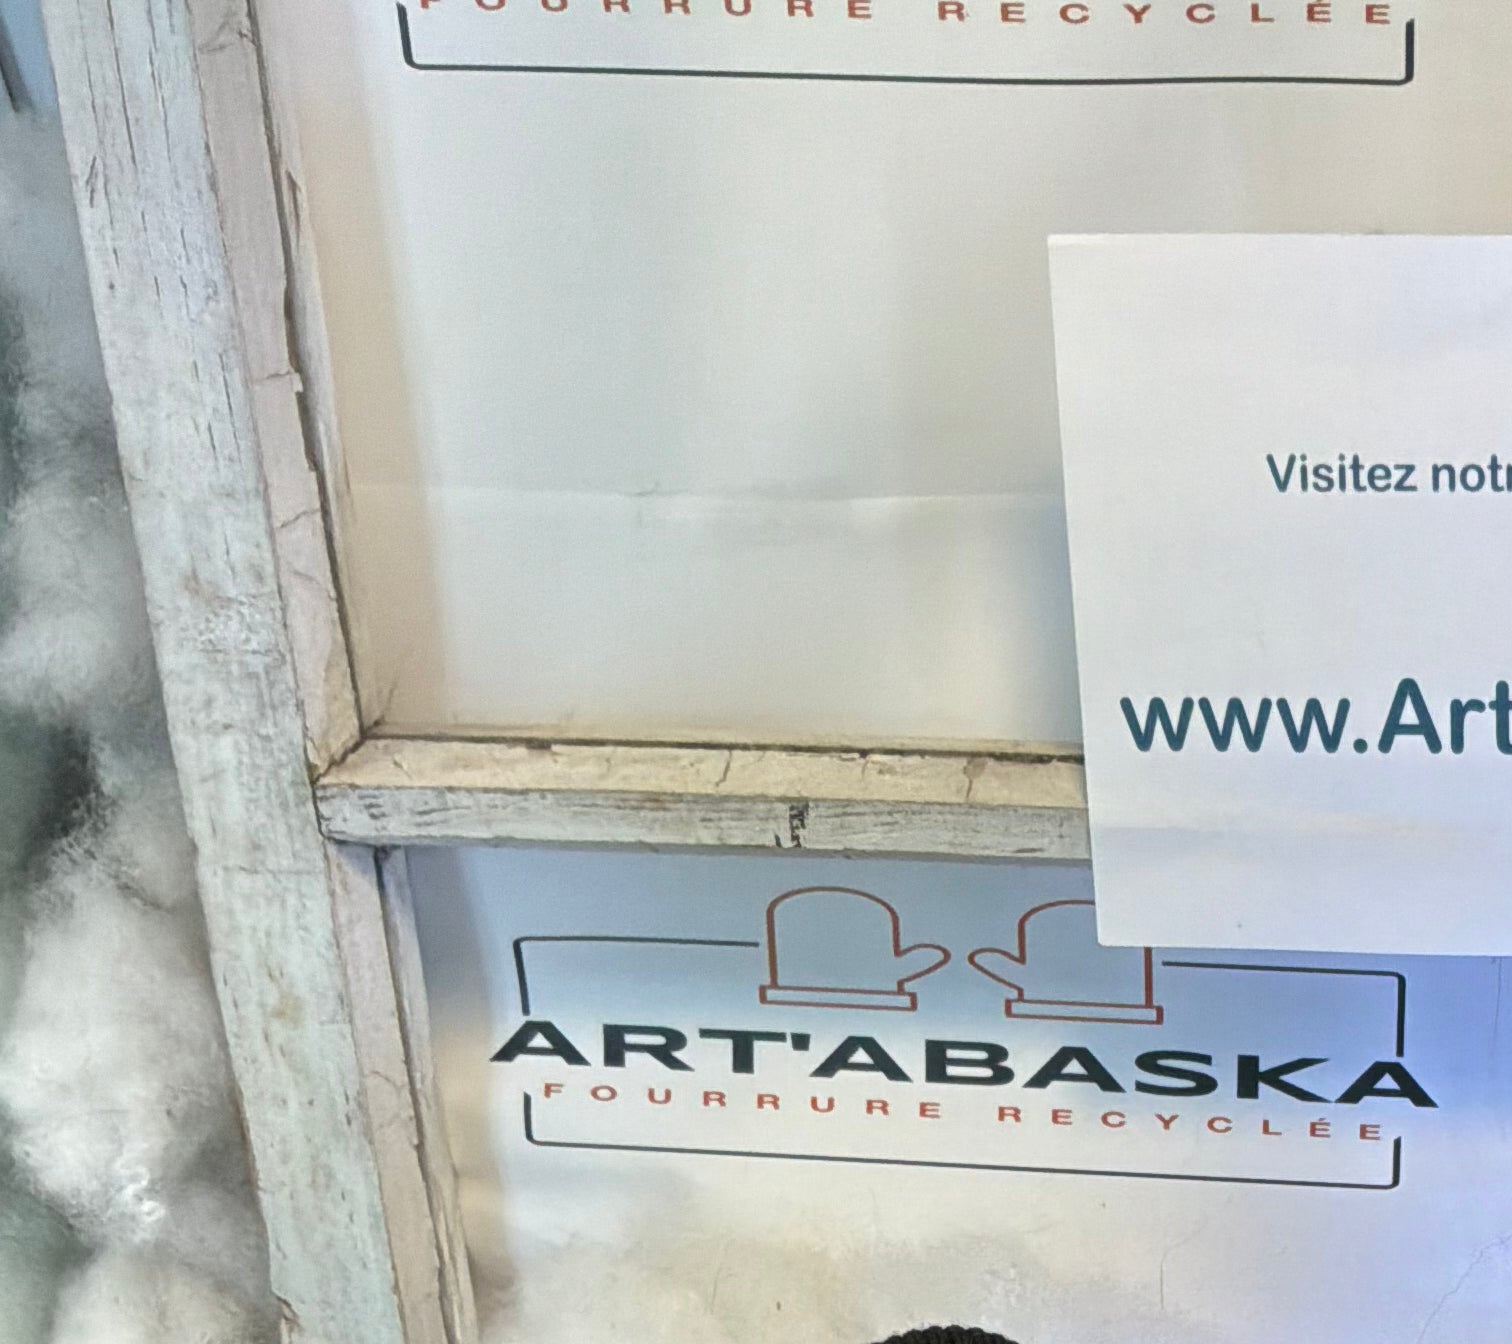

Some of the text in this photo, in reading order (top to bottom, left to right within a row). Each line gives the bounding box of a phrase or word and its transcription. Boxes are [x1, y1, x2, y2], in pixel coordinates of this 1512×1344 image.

[937, 0, 1390, 25] RECYCLÉE
[1266, 454, 1417, 492] Visitez
[489, 1019, 1440, 1109] ART'ABASKA
[543, 1082, 1383, 1141] FOURRURE RECYCLÉE
